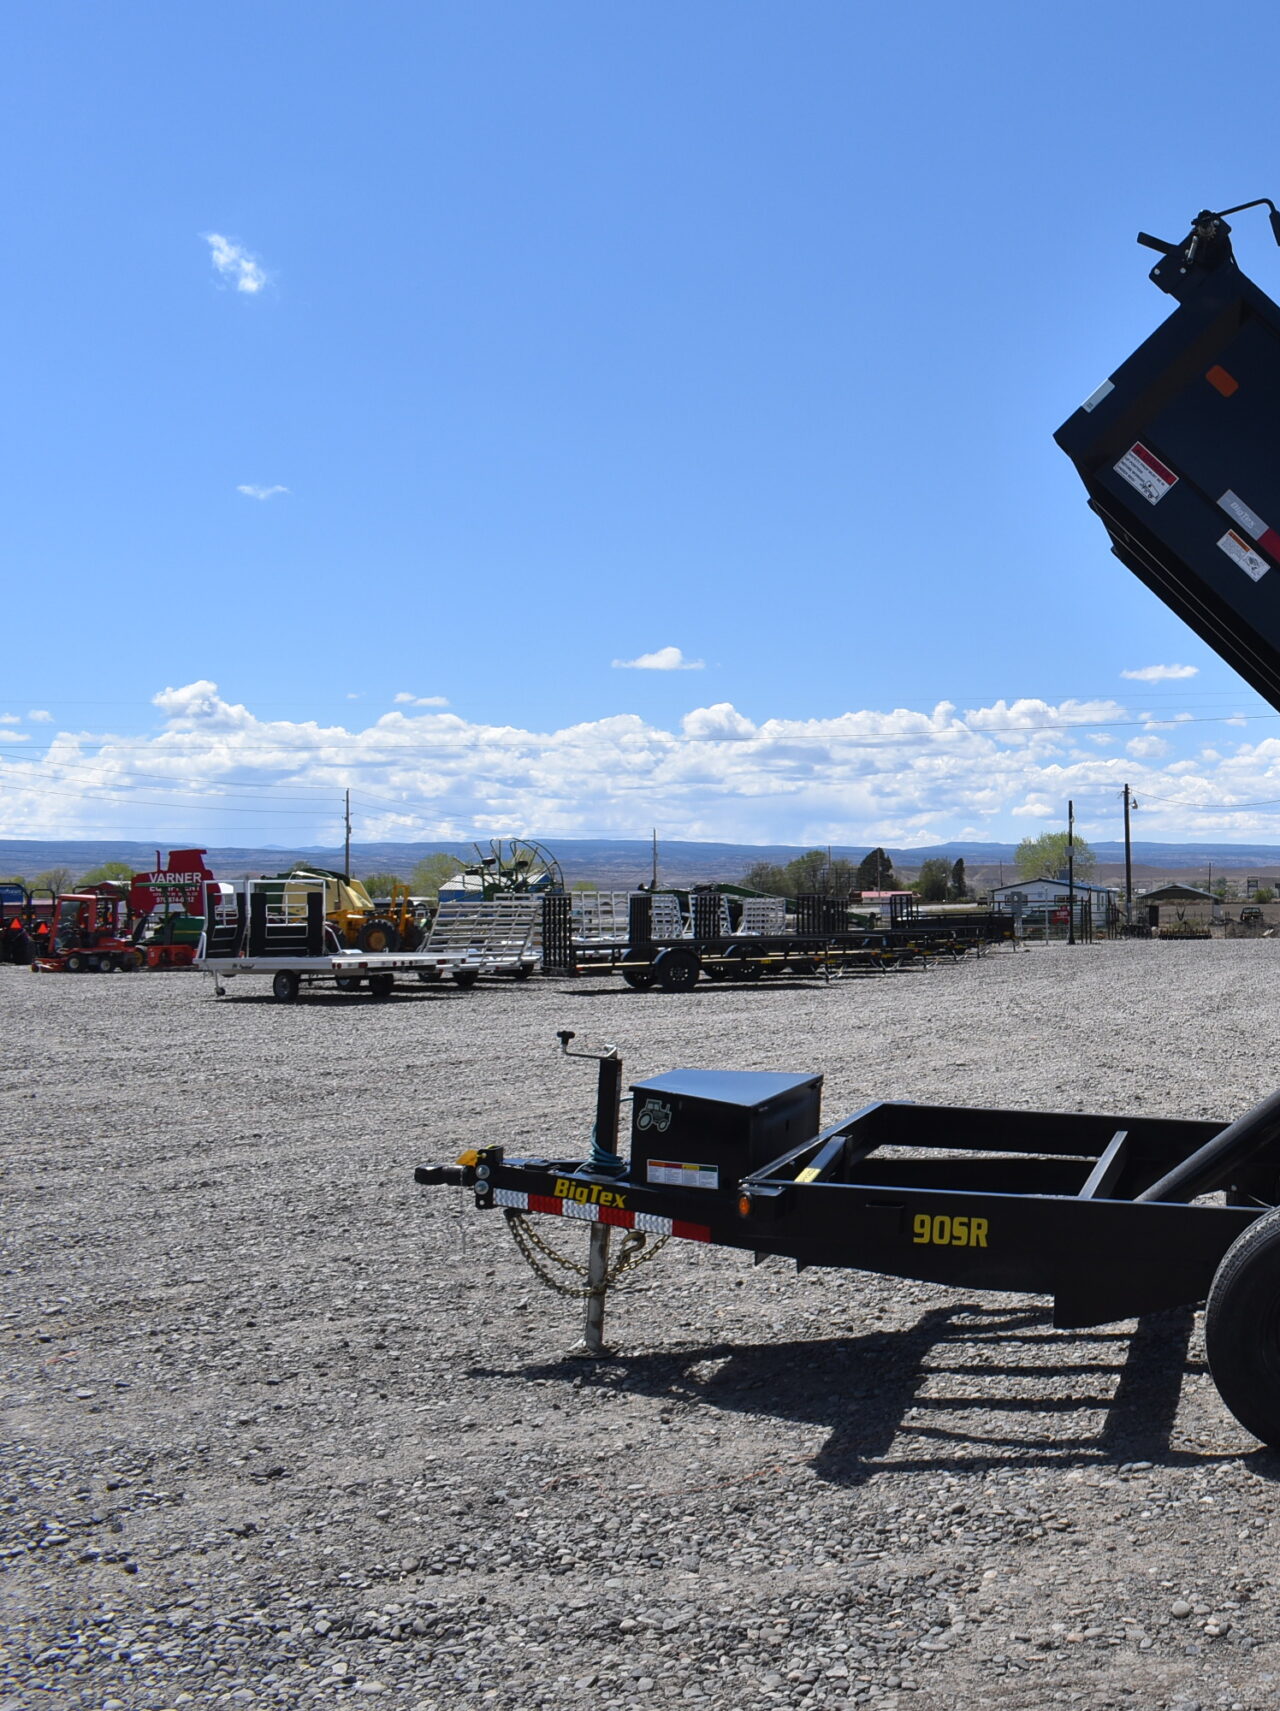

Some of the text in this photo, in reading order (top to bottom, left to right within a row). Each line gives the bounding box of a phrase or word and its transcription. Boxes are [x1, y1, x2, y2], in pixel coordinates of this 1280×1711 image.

[149, 872, 202, 884] VARNER
[553, 1178, 626, 1208] BigTex
[913, 1213, 988, 1248] 90SR
